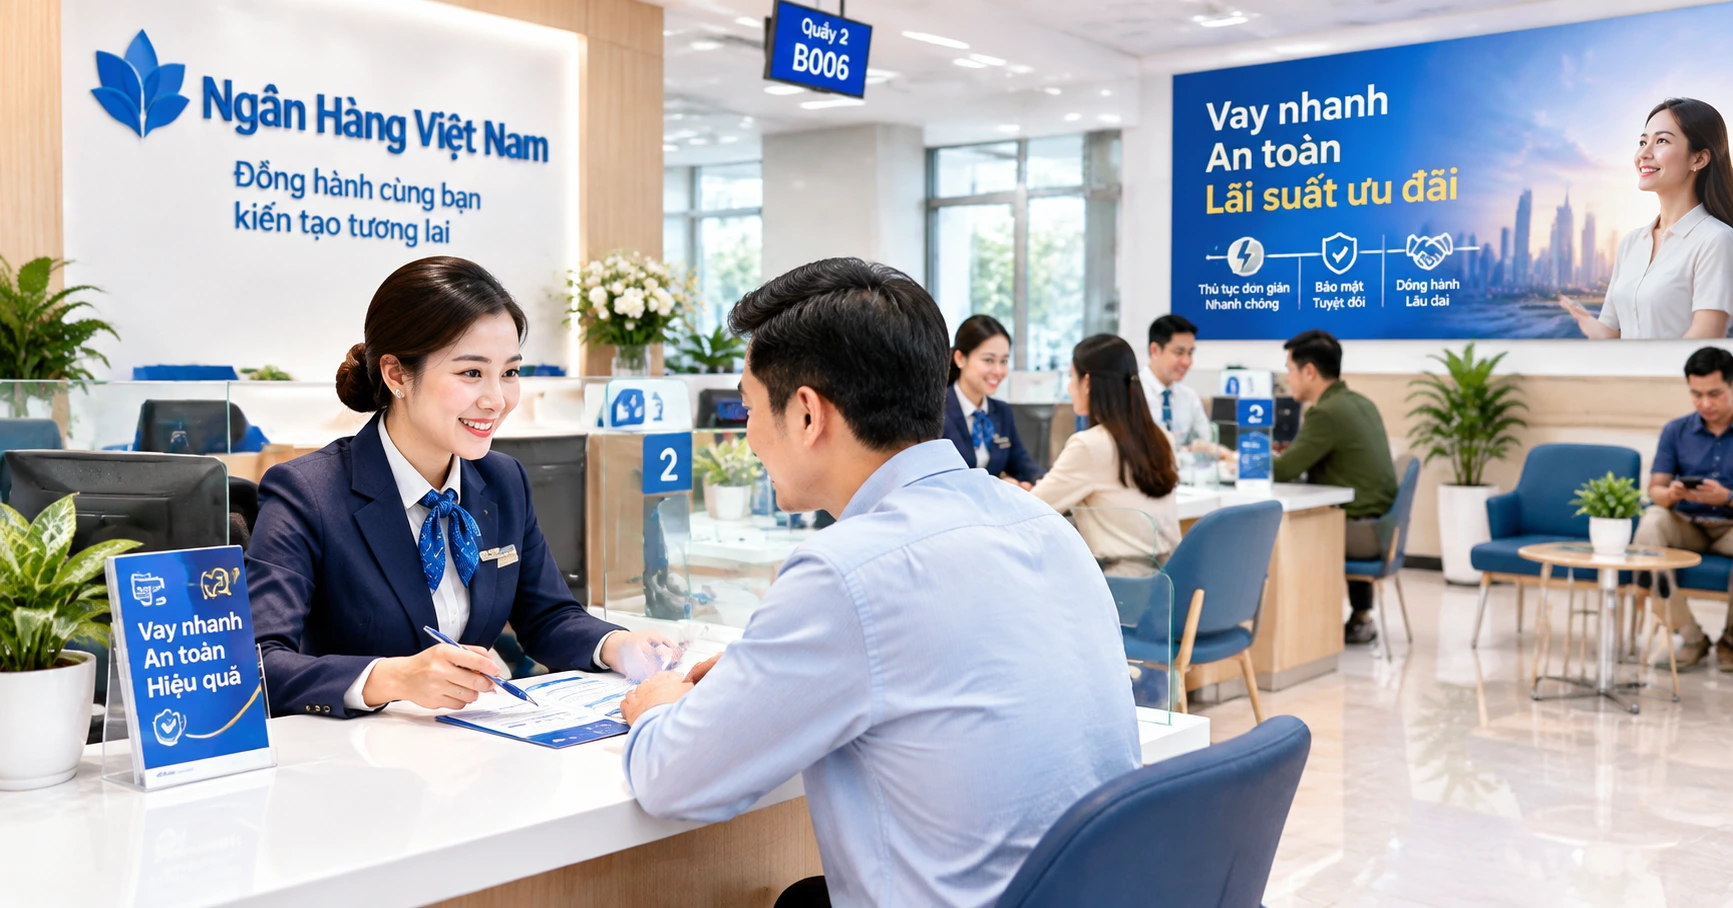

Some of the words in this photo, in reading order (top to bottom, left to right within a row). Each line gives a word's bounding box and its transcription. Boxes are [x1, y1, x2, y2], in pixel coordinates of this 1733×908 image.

[839, 28, 849, 45] 2
[792, 42, 850, 81] B006
[202, 75, 306, 135] Ngân
[317, 93, 407, 154] Hàng
[414, 109, 477, 161] Việt
[484, 120, 549, 163] Nam
[1206, 101, 1270, 136] Vay
[1279, 84, 1388, 125] nhanh
[1205, 142, 1253, 173] An
[1261, 133, 1341, 168] toàn
[234, 160, 306, 199] Đồng
[314, 168, 373, 200] hành
[379, 177, 434, 211] cùng
[441, 182, 481, 213] bạn
[1206, 180, 1253, 214] Lãi
[1262, 173, 1338, 211] suất
[1347, 177, 1392, 206] ưu
[1402, 166, 1458, 203] đãi
[234, 201, 292, 232] kiến
[299, 209, 341, 240] tạo
[350, 213, 418, 247] tương
[425, 218, 450, 244] lai
[1205, 298, 1242, 310] Nhanh
[660, 447, 679, 482] 2
[137, 621, 177, 643] Vay
[182, 611, 243, 636] nhanh
[143, 648, 174, 669] An
